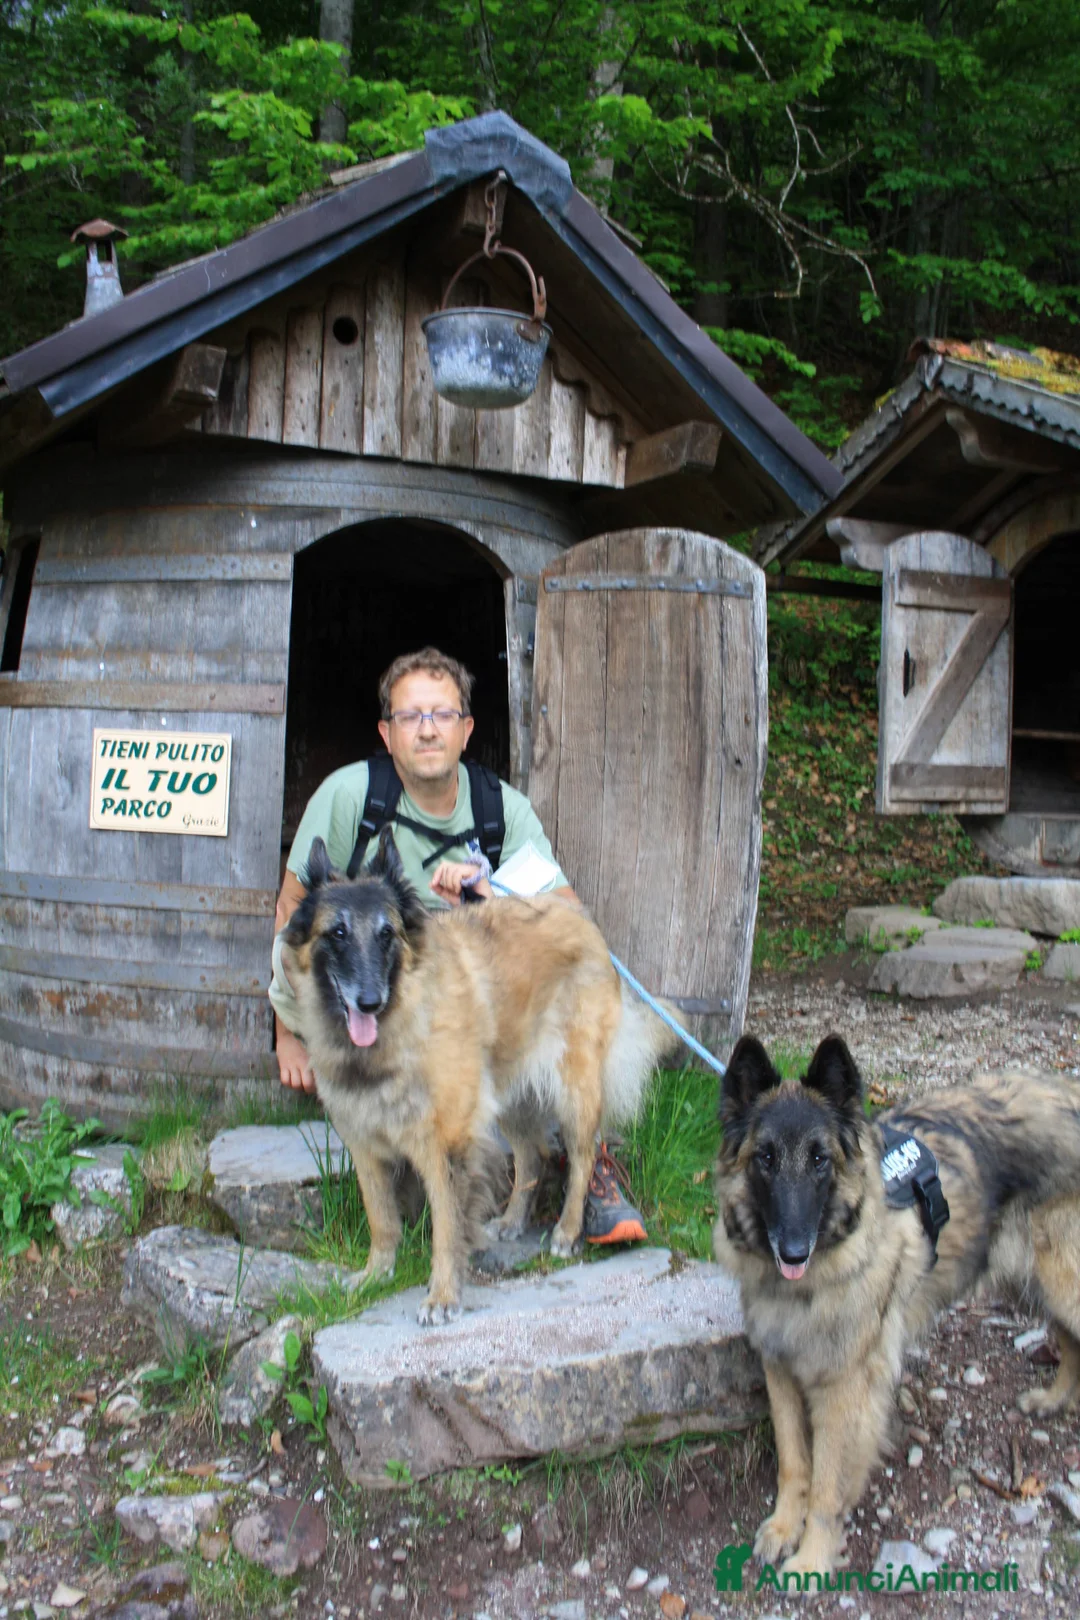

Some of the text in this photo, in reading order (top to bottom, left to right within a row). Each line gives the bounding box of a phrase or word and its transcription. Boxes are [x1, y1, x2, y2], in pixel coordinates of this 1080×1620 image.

[101, 740, 224, 762] TIENI PULITO
[101, 768, 217, 794] IL TUO
[101, 798, 172, 818] PARCO
[182, 815, 219, 829] Grazie
